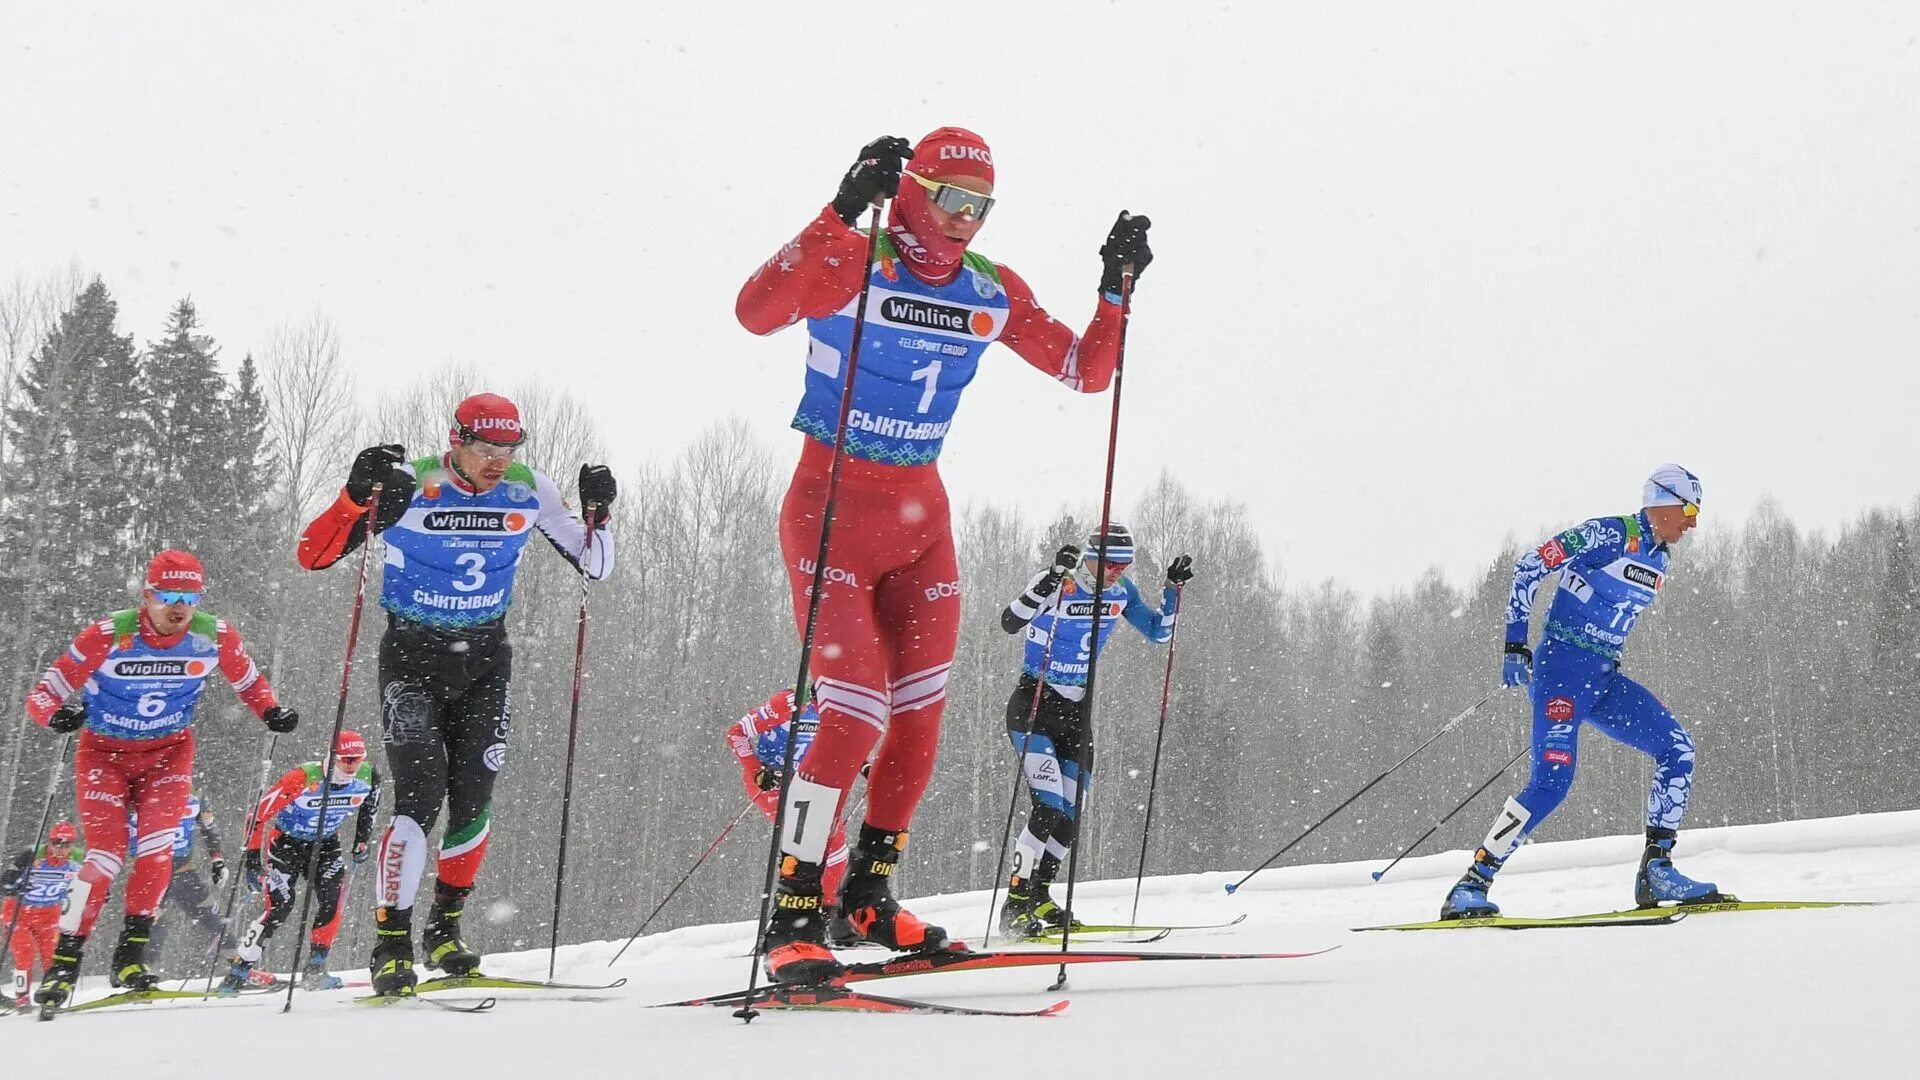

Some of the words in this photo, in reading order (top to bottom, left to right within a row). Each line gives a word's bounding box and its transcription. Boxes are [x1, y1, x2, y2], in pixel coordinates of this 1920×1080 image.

[890, 300, 964, 329] Winline
[899, 337, 942, 352] TELESPORT
[942, 343, 969, 357] GROUP
[911, 360, 943, 414] 1
[431, 514, 499, 528] Winline
[452, 552, 487, 592] 3
[1627, 565, 1656, 587] Winline
[1567, 574, 1587, 593] 17
[413, 589, 505, 611] СЫКТЫВКАР
[1070, 603, 1108, 615] Winle
[1609, 600, 1646, 632] 17
[1028, 628, 1036, 639] 9
[137, 691, 166, 718] 6
[103, 710, 184, 731] СЫКТЫВКАР
[311, 799, 348, 807] Wline
[793, 800, 811, 845] 1
[1493, 810, 1522, 842] 7
[385, 840, 407, 902] TATARS
[1013, 850, 1023, 875] 9
[29, 883, 61, 897] 20
[1678, 903, 1740, 914] FISCHER
[244, 929, 257, 948] 3
